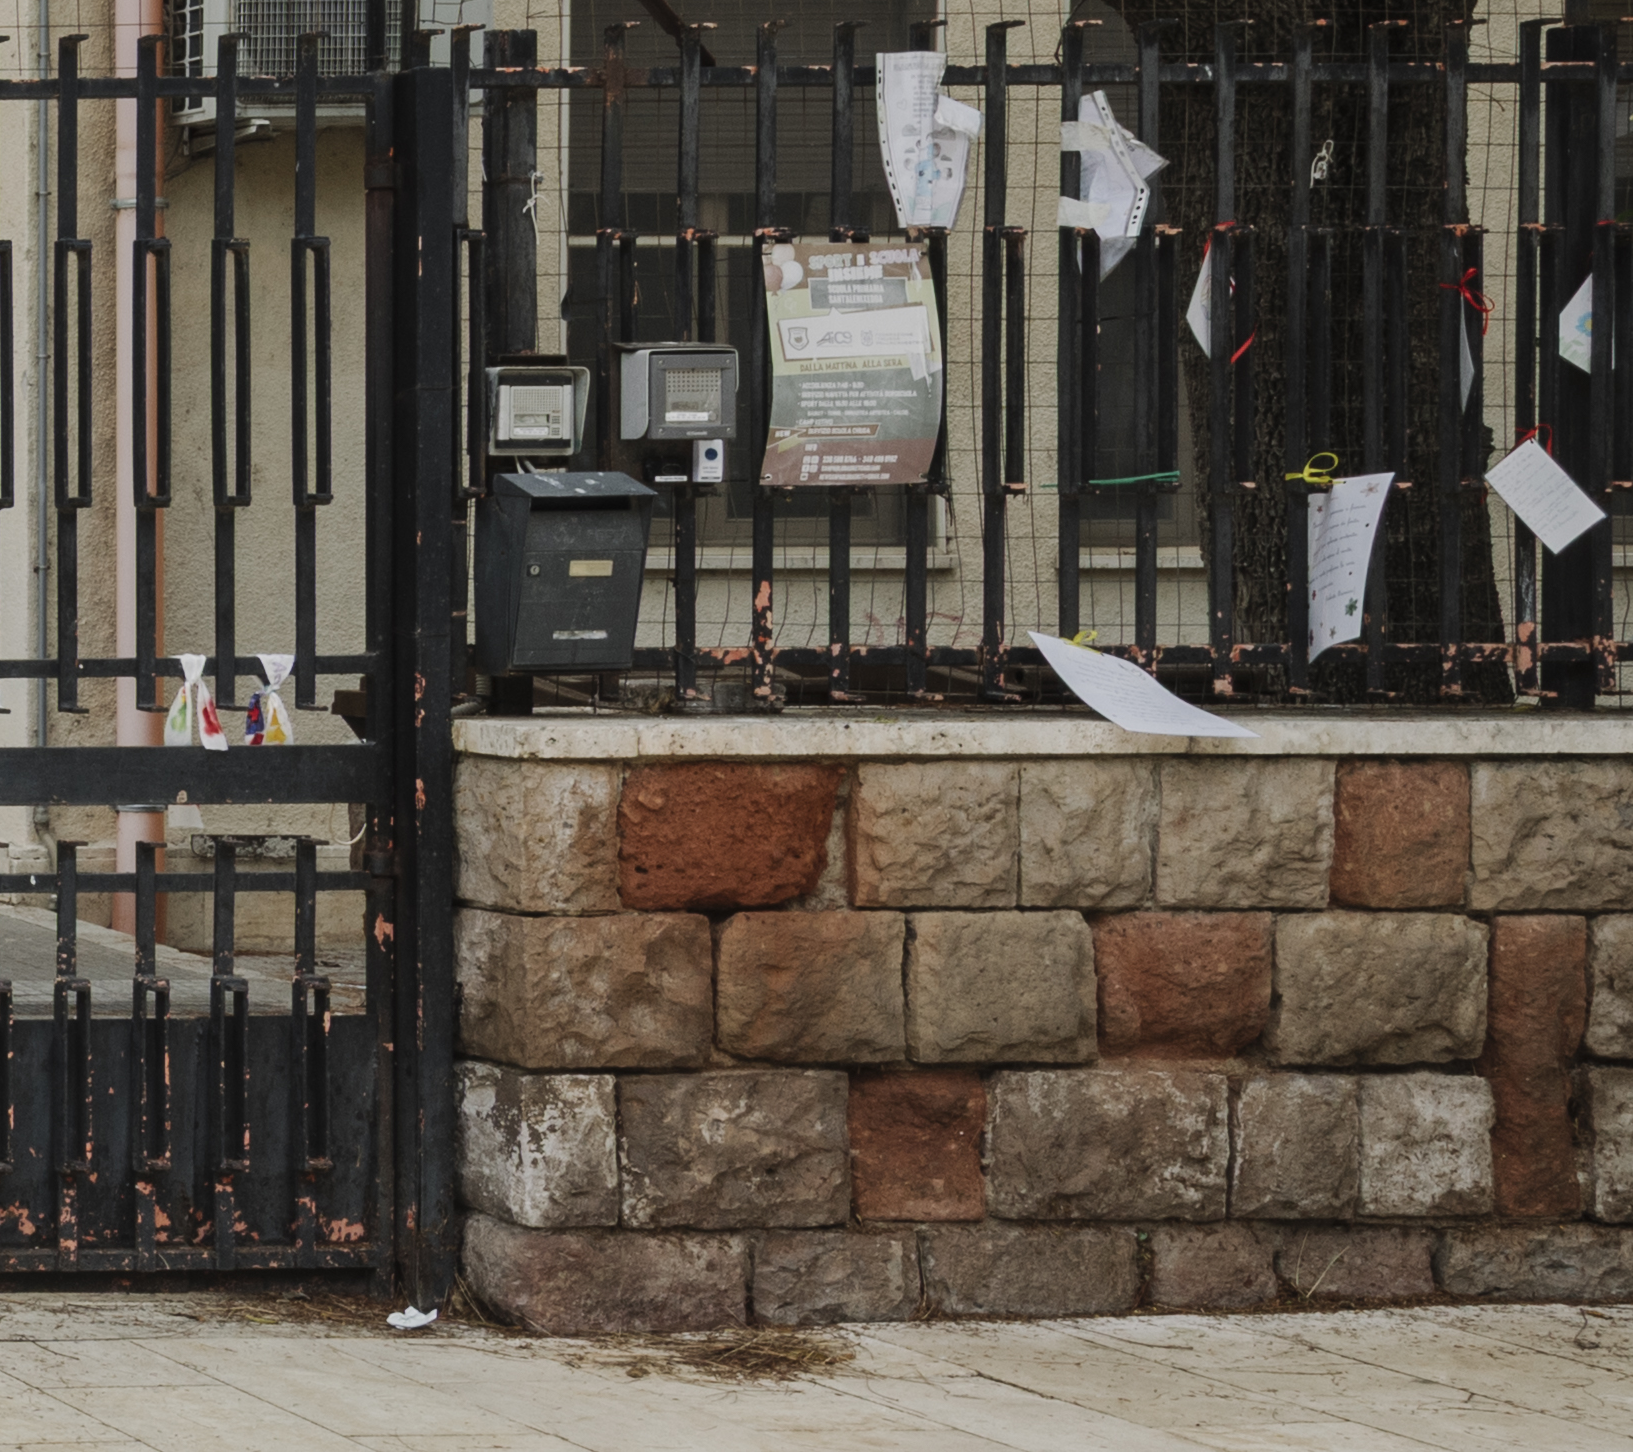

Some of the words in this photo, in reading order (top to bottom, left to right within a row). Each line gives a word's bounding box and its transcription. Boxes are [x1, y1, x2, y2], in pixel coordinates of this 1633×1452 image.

[808, 253, 852, 270] SPORT
[869, 248, 920, 265] SCUOLA
[827, 264, 884, 282] INSIEME
[800, 363, 824, 372] DALLA
[825, 362, 858, 371] MATTINA
[862, 361, 882, 369] ALLA
[882, 360, 903, 368] SERA
